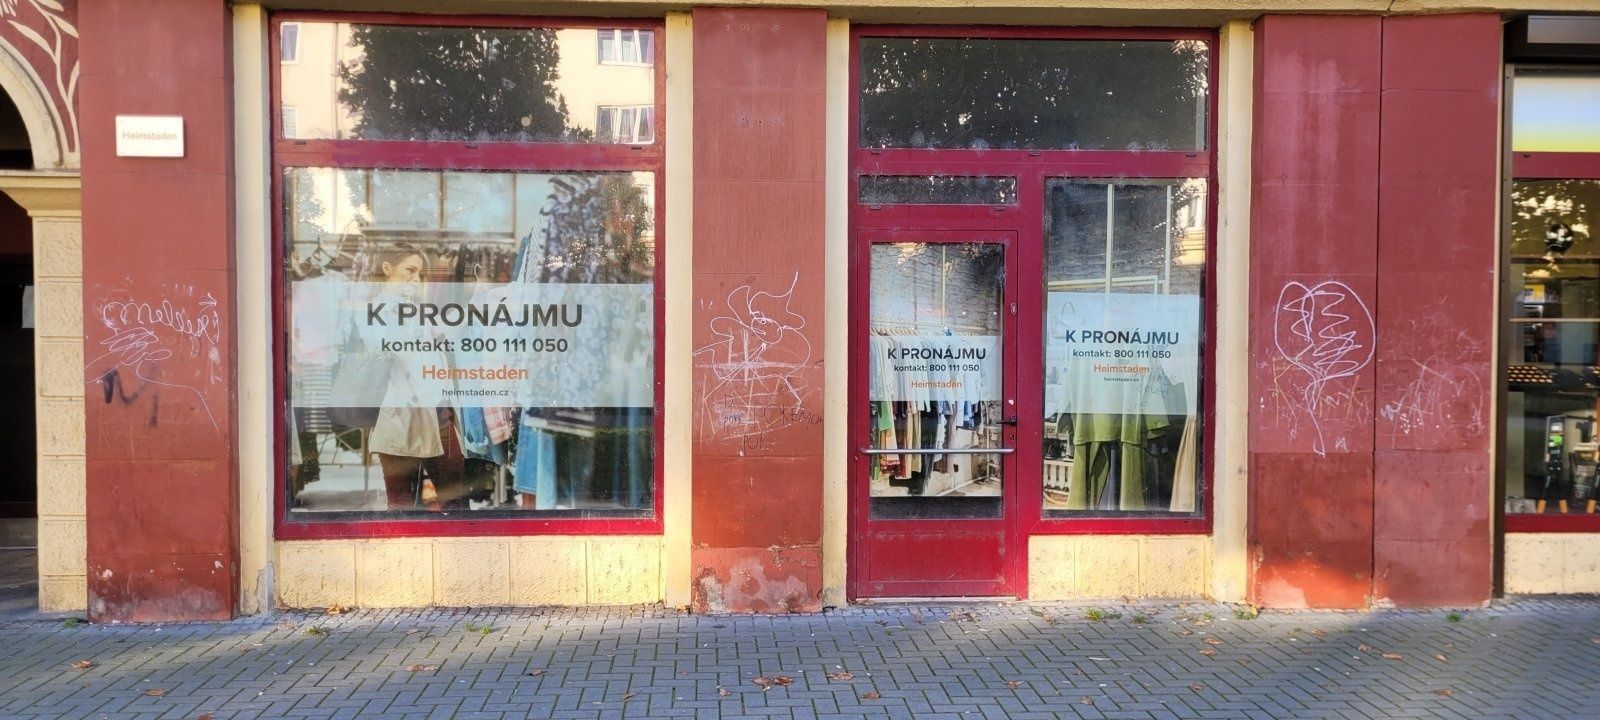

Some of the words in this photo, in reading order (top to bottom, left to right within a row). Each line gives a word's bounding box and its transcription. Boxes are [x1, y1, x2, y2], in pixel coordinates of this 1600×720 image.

[122, 131, 178, 141] Heimstaden
[367, 302, 386, 327] K
[398, 297, 583, 328] PRONÁJMU
[1065, 329, 1076, 343] K
[1081, 327, 1179, 345] PRONÁJMU
[381, 337, 455, 353] kontakt:
[460, 338, 497, 353] 800
[503, 338, 527, 353] 111
[532, 338, 569, 353] 050
[887, 348, 897, 360] K
[901, 344, 987, 360] PRONÁJMU
[1072, 348, 1112, 358] kontakt:
[1114, 349, 1134, 358] 800
[1137, 350, 1149, 359] 111
[1151, 350, 1171, 359] 050
[421, 364, 529, 380] Heimstaden
[894, 363, 927, 372] kontakt:
[929, 364, 947, 372] 800
[948, 364, 960, 372] 111
[962, 364, 980, 372] 050
[1093, 363, 1150, 374] Heimstaden
[911, 380, 963, 389] Heimstaden
[441, 387, 510, 398] heimstaden.cz
